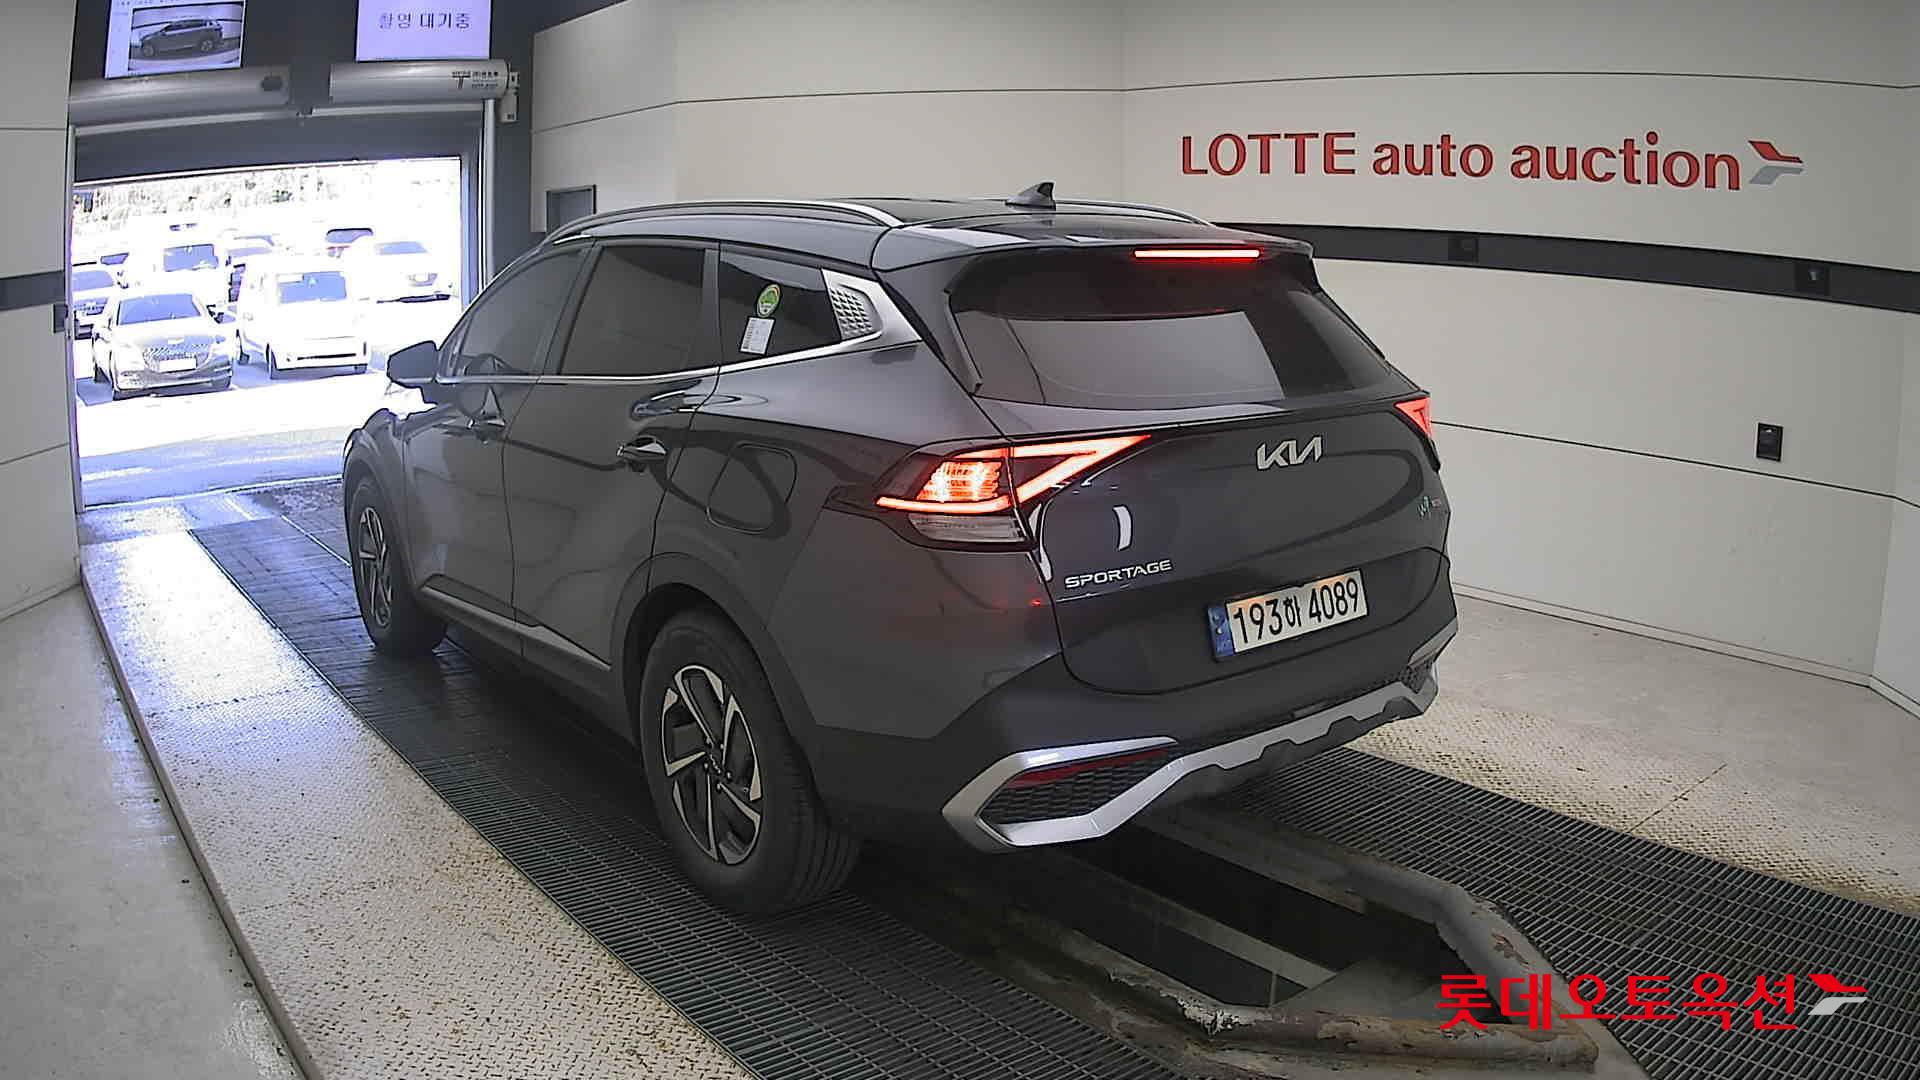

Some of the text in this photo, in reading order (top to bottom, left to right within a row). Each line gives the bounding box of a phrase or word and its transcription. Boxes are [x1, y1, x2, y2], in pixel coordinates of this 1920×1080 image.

[420, 11, 470, 29] 대기중
[1182, 131, 1741, 191] LOTTE auto auction
[1256, 435, 1323, 470] KIA
[1064, 559, 1173, 589] SPORTAGE
[1233, 577, 1359, 644] 193하 4089
